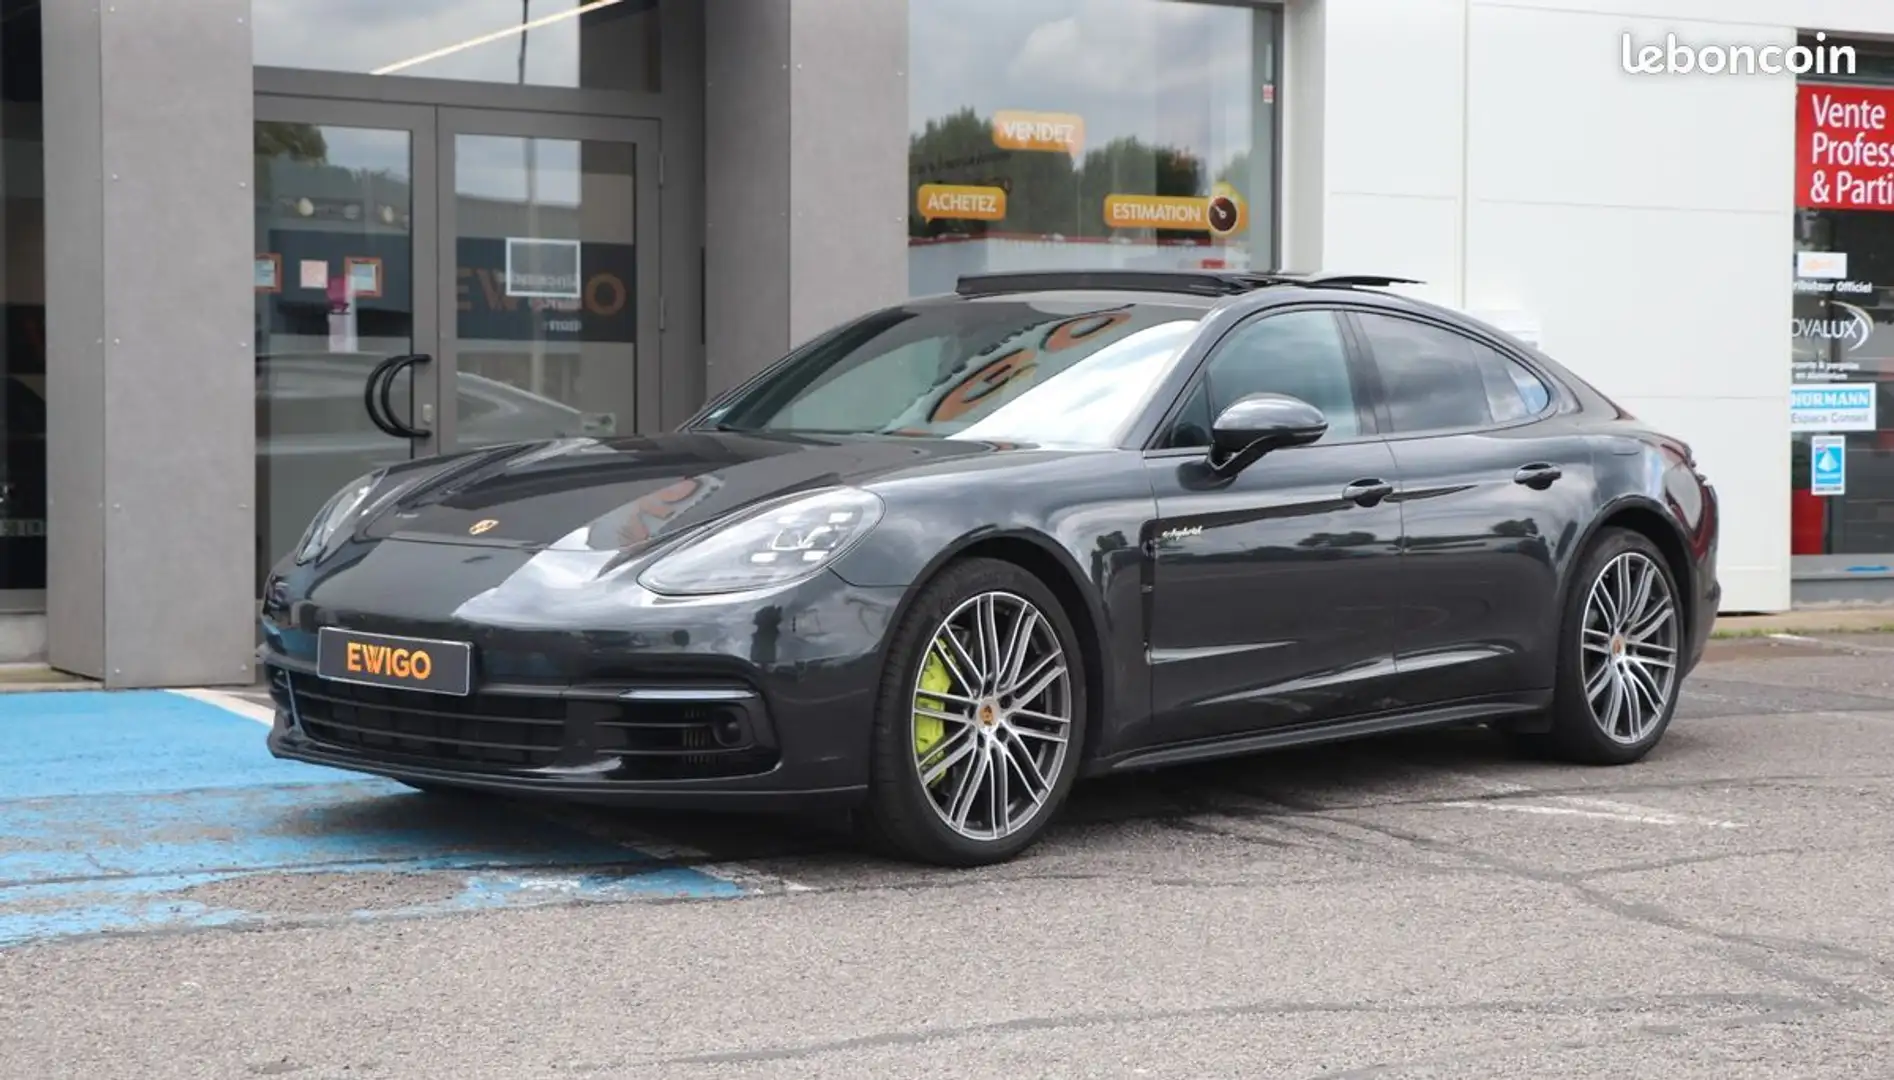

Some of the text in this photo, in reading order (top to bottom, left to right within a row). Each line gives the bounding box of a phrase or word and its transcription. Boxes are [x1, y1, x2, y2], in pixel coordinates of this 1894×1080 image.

[1811, 93, 1886, 130] Vente
[1000, 119, 1075, 143] VENDEZ
[1810, 169, 1893, 204] & Parti
[927, 193, 997, 213] ACHETEZ
[1112, 202, 1201, 222] ESTIMATION
[347, 642, 431, 680] EWIGO
